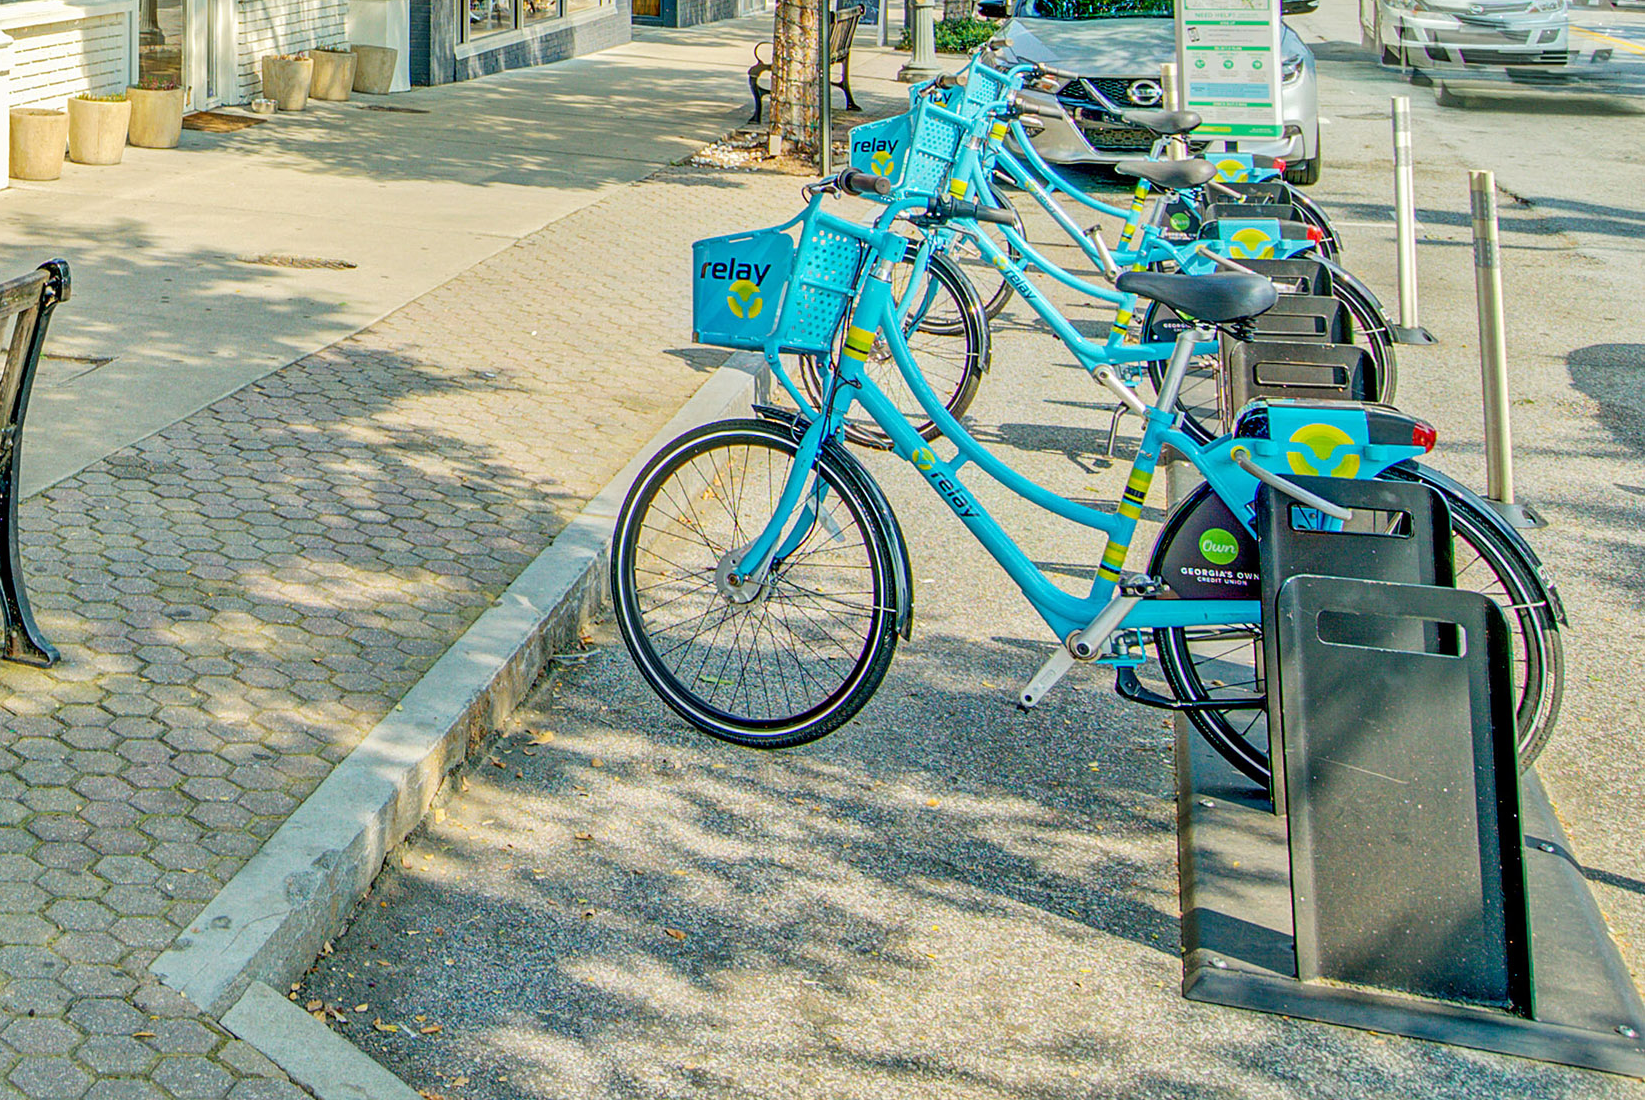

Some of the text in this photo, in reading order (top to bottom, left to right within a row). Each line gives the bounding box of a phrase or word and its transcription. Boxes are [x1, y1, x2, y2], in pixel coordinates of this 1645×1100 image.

[915, 89, 953, 104] rlay
[853, 137, 899, 155] relay
[700, 257, 771, 286] relay
[1005, 270, 1036, 299] relay
[930, 472, 981, 517] relay
[1202, 539, 1237, 554] Own
[1180, 567, 1260, 580] GEORGIA'S OWN
[1197, 576, 1248, 586] CREDIT UNION
